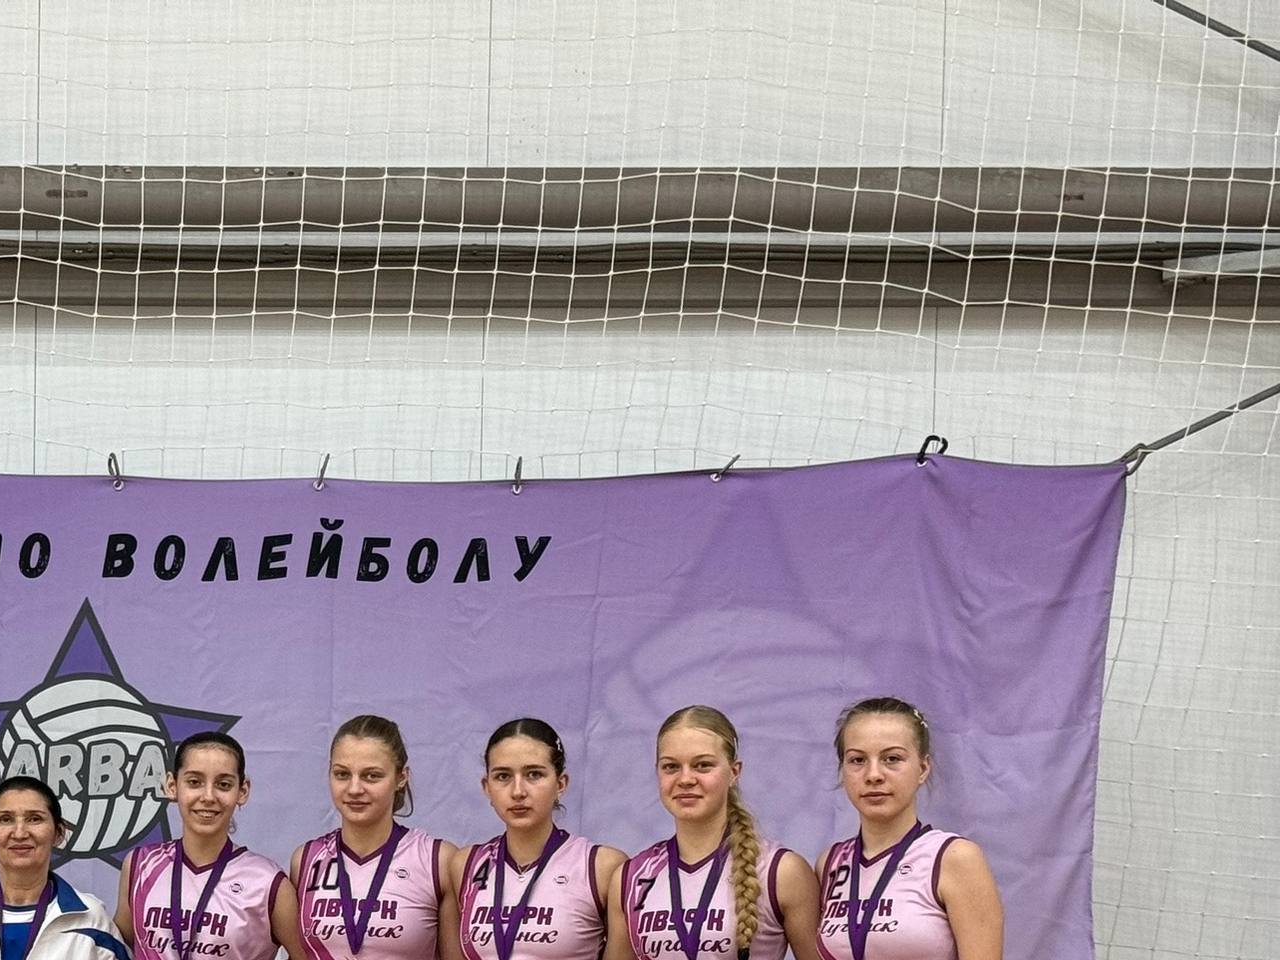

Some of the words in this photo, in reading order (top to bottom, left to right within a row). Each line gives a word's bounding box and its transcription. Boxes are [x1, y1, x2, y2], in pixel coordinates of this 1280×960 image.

[102, 517, 552, 584] ВОЛЕЙБОЛУ
[307, 858, 341, 893] 10
[472, 861, 490, 890] 4
[634, 878, 655, 911] 7
[311, 899, 397, 920] ЛВФК
[305, 919, 404, 940] Лугнск
[463, 927, 558, 946] Лунск
[821, 921, 898, 937] Лугск
[634, 936, 730, 958] Лугаск
